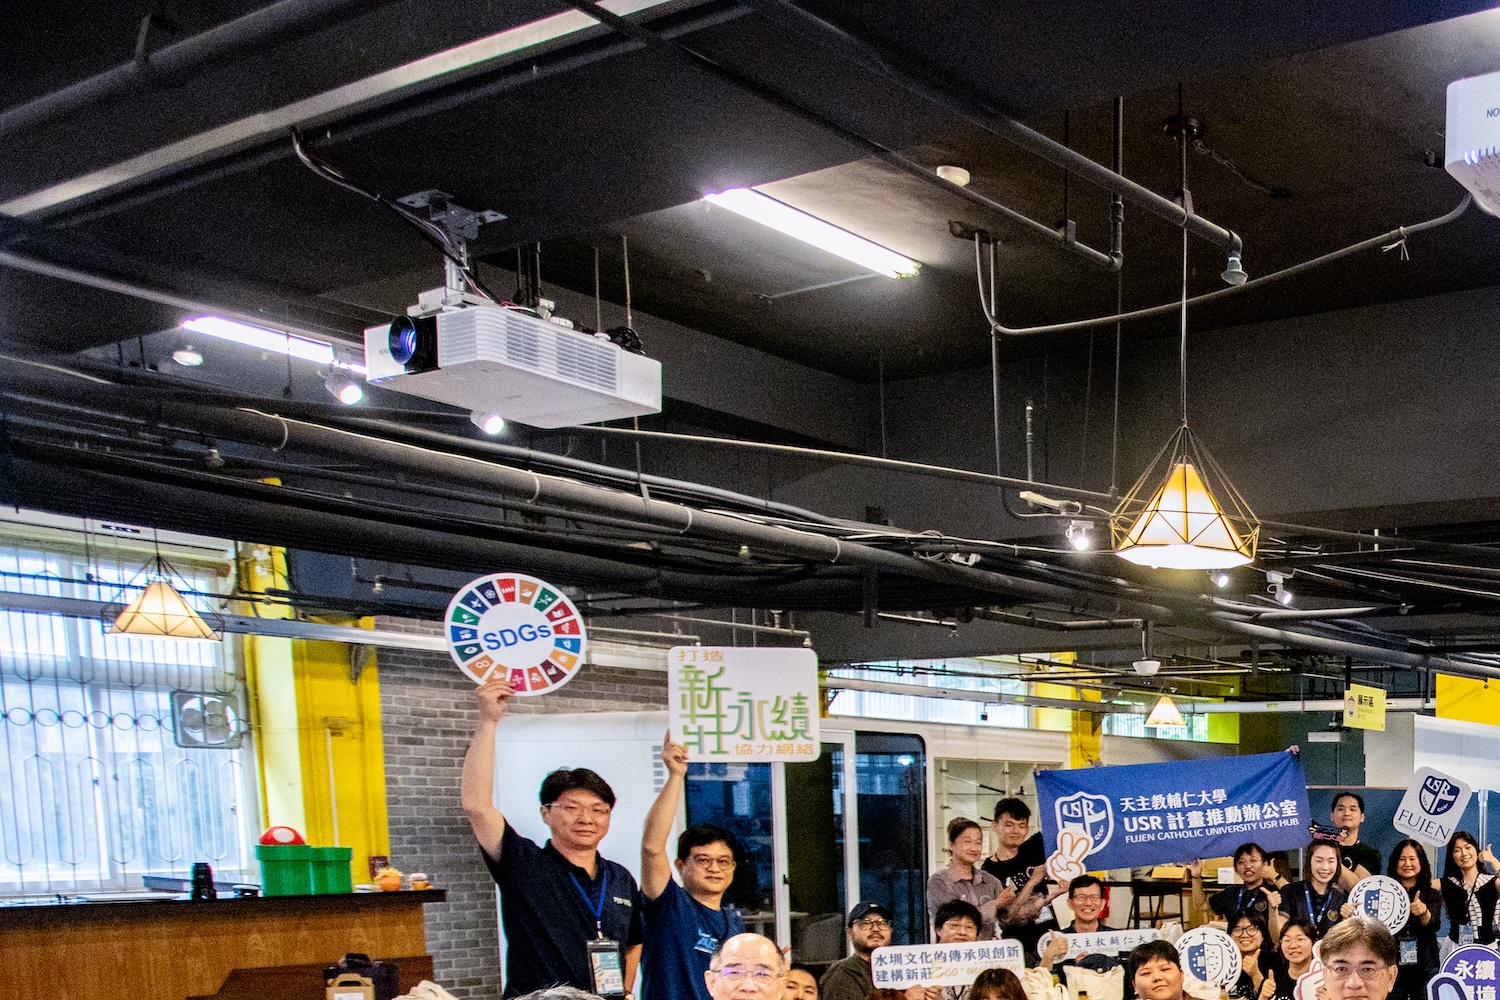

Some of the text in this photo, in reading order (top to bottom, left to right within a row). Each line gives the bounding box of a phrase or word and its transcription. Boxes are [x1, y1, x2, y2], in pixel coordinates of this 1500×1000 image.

[483, 624, 551, 651] SDGs
[678, 650, 724, 662] 打造
[734, 744, 814, 755] 協力網絡
[1120, 788, 1227, 812] 天主教輔仁大學
[1123, 799, 1299, 833] USR 計畫推動辦公室
[1398, 809, 1451, 840] FUJEN
[1125, 817, 1299, 844] FUJEN CATHOLIC UNIVERSITY USR HUB
[874, 945, 1019, 967] 水圳文化的傳承與創新
[875, 967, 932, 983] 建構新莊
[1454, 959, 1496, 980] 永續
